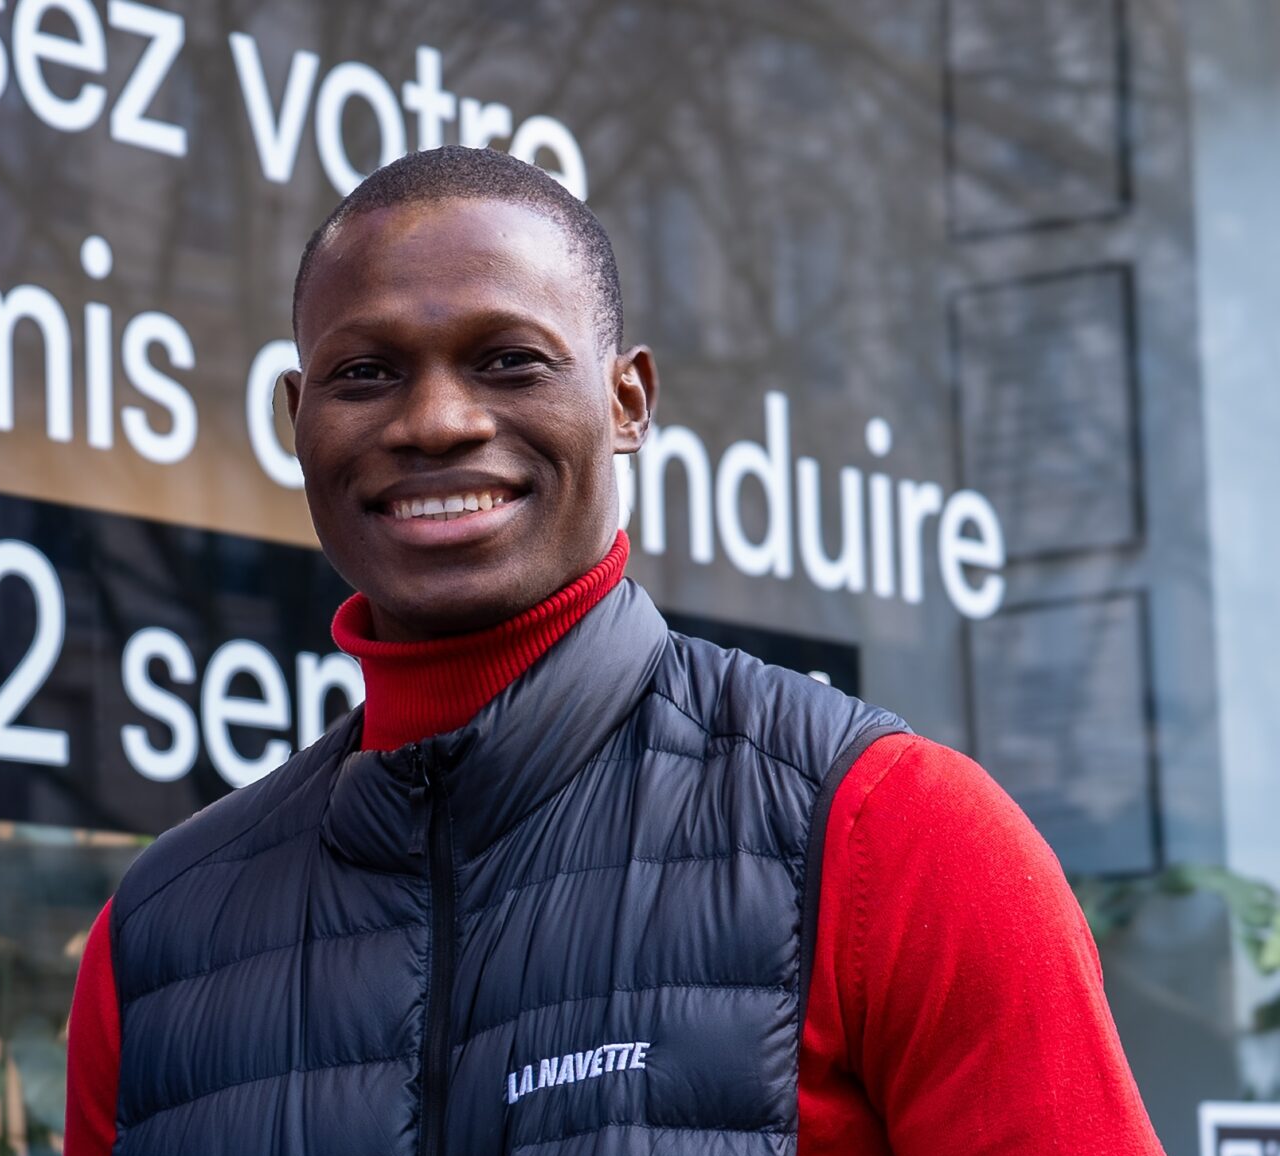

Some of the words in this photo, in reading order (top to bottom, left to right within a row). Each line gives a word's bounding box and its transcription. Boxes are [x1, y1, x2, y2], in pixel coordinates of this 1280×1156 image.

[617, 391, 1006, 619] nduire
[507, 1064, 533, 1105] LA
[537, 1041, 651, 1089] NAVETTE
